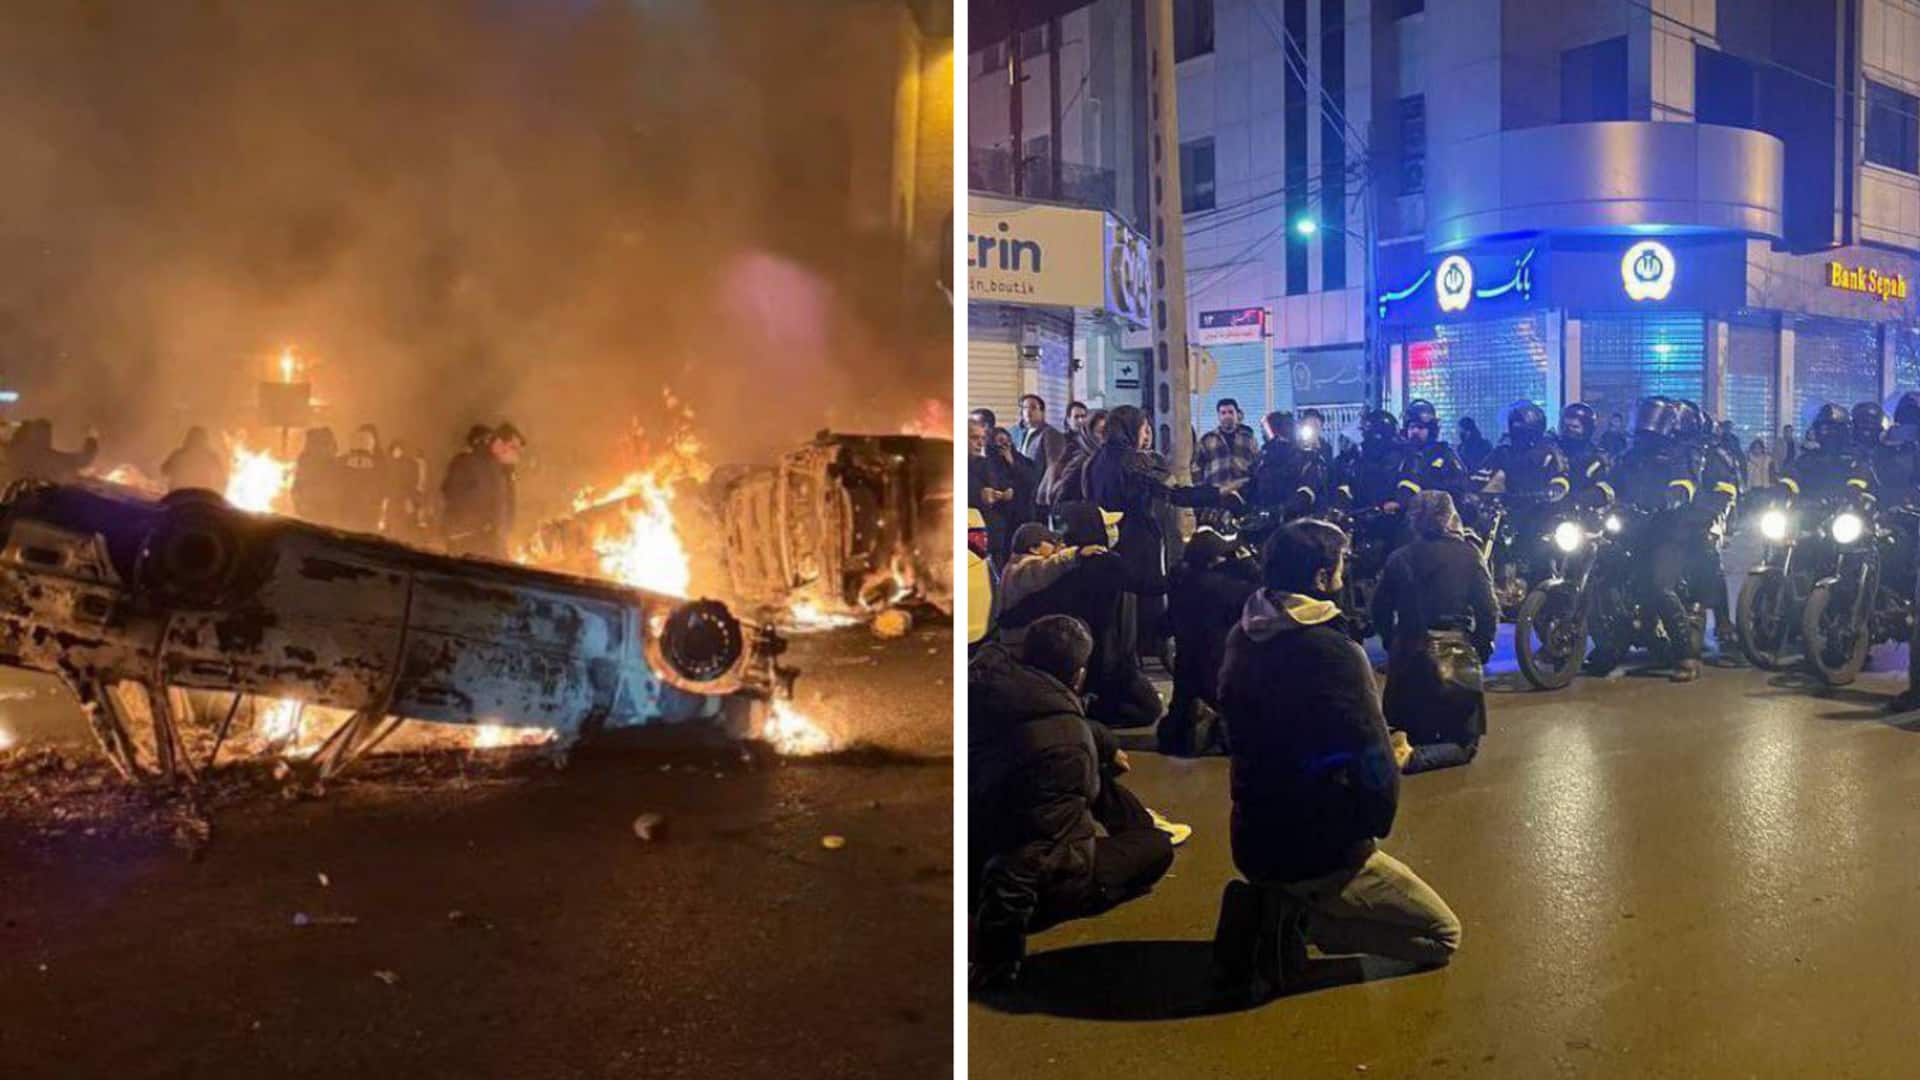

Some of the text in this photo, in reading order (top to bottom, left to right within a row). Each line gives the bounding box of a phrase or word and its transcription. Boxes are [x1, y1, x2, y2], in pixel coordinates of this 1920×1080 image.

[1476, 247, 1535, 301] بانک
[1832, 262, 1906, 301] Bank Sepah
